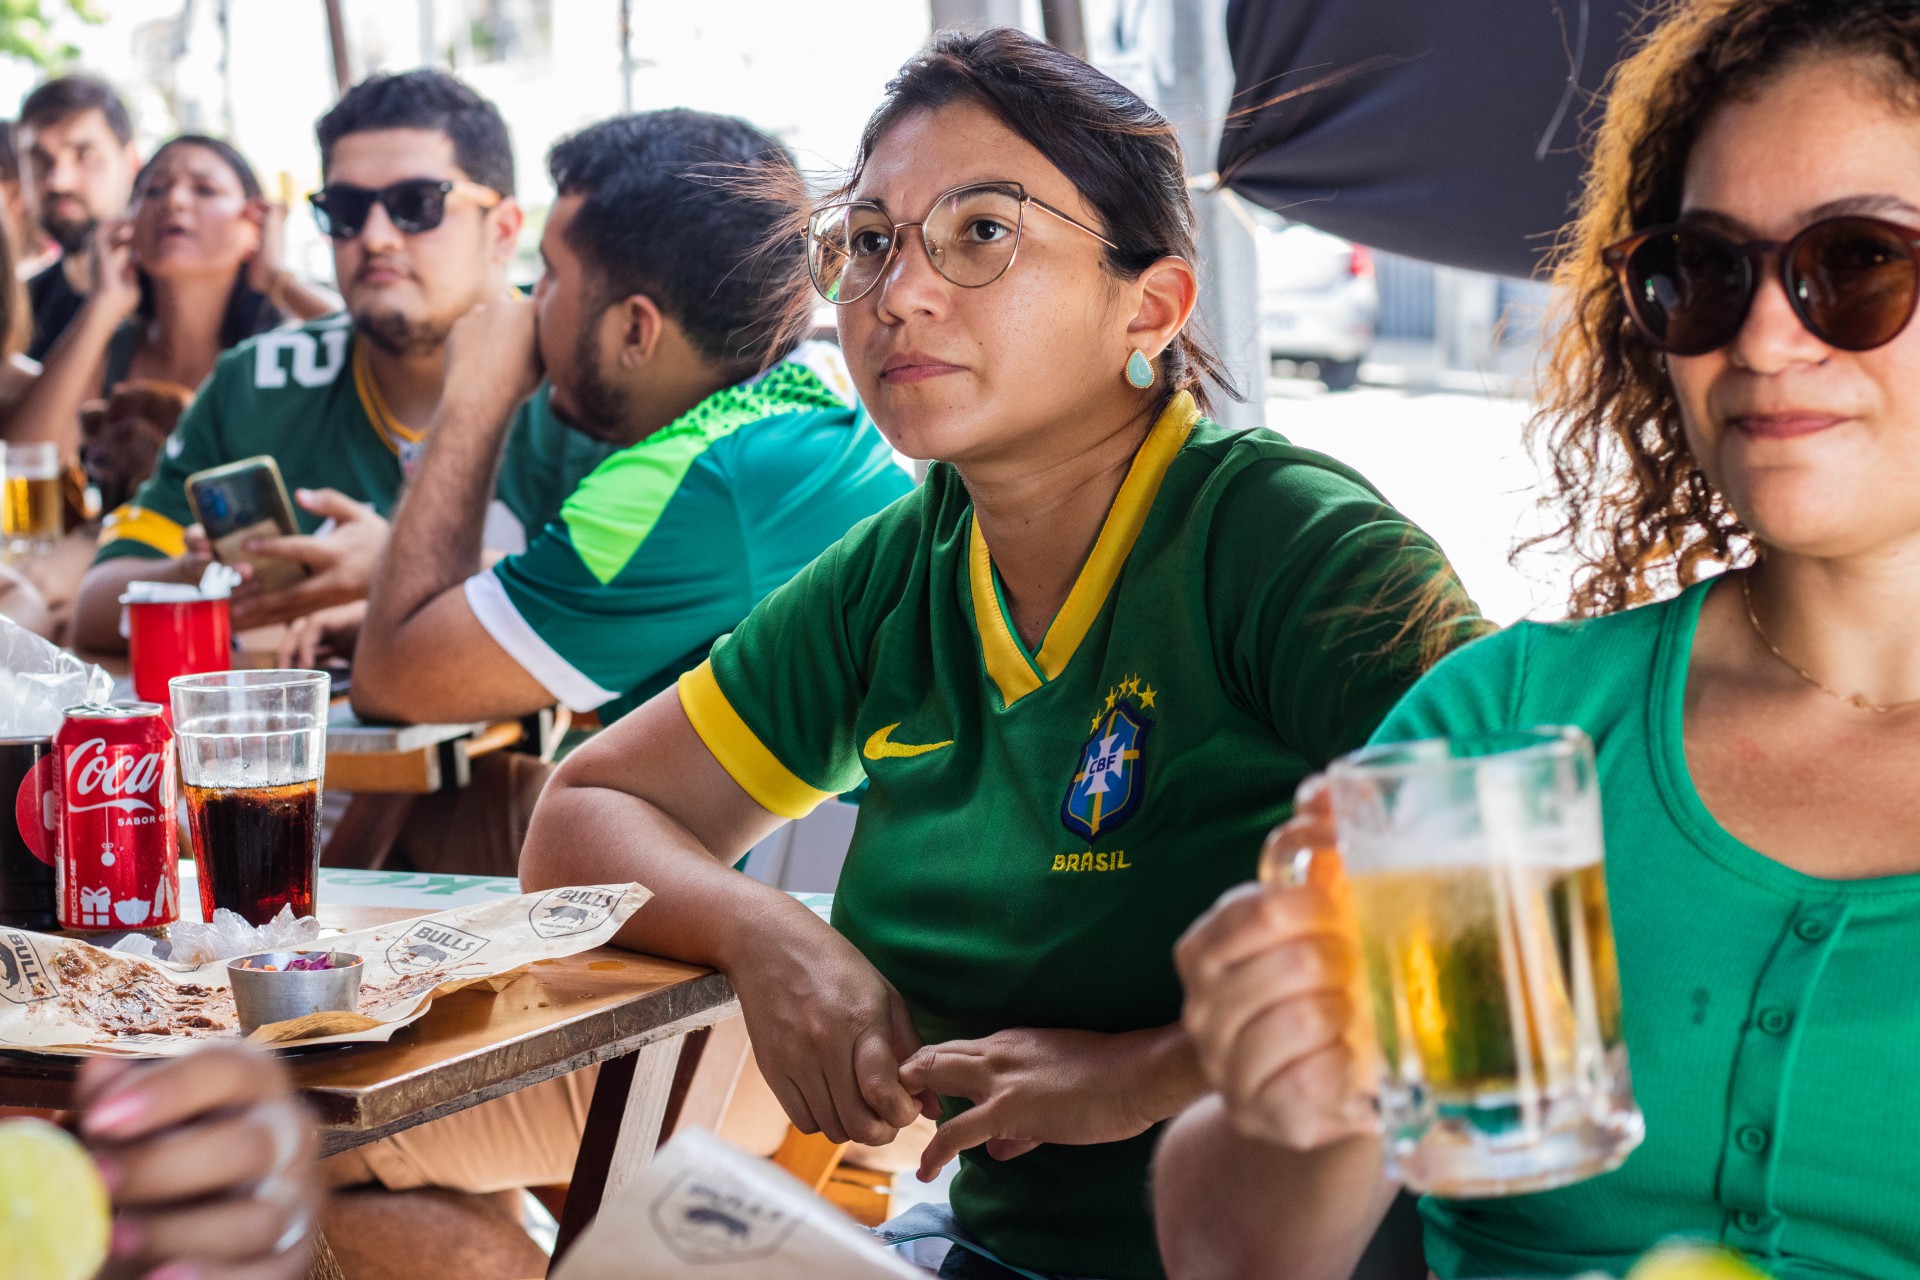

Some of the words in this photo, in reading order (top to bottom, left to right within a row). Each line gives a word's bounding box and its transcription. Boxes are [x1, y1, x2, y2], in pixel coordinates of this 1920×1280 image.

[1088, 754, 1117, 775] CBF
[117, 814, 156, 828] SABOR
[1051, 850, 1132, 873] BRASIL
[556, 889, 614, 909] BULLS
[413, 926, 476, 952] BULLS
[7, 934, 46, 990] BULL
